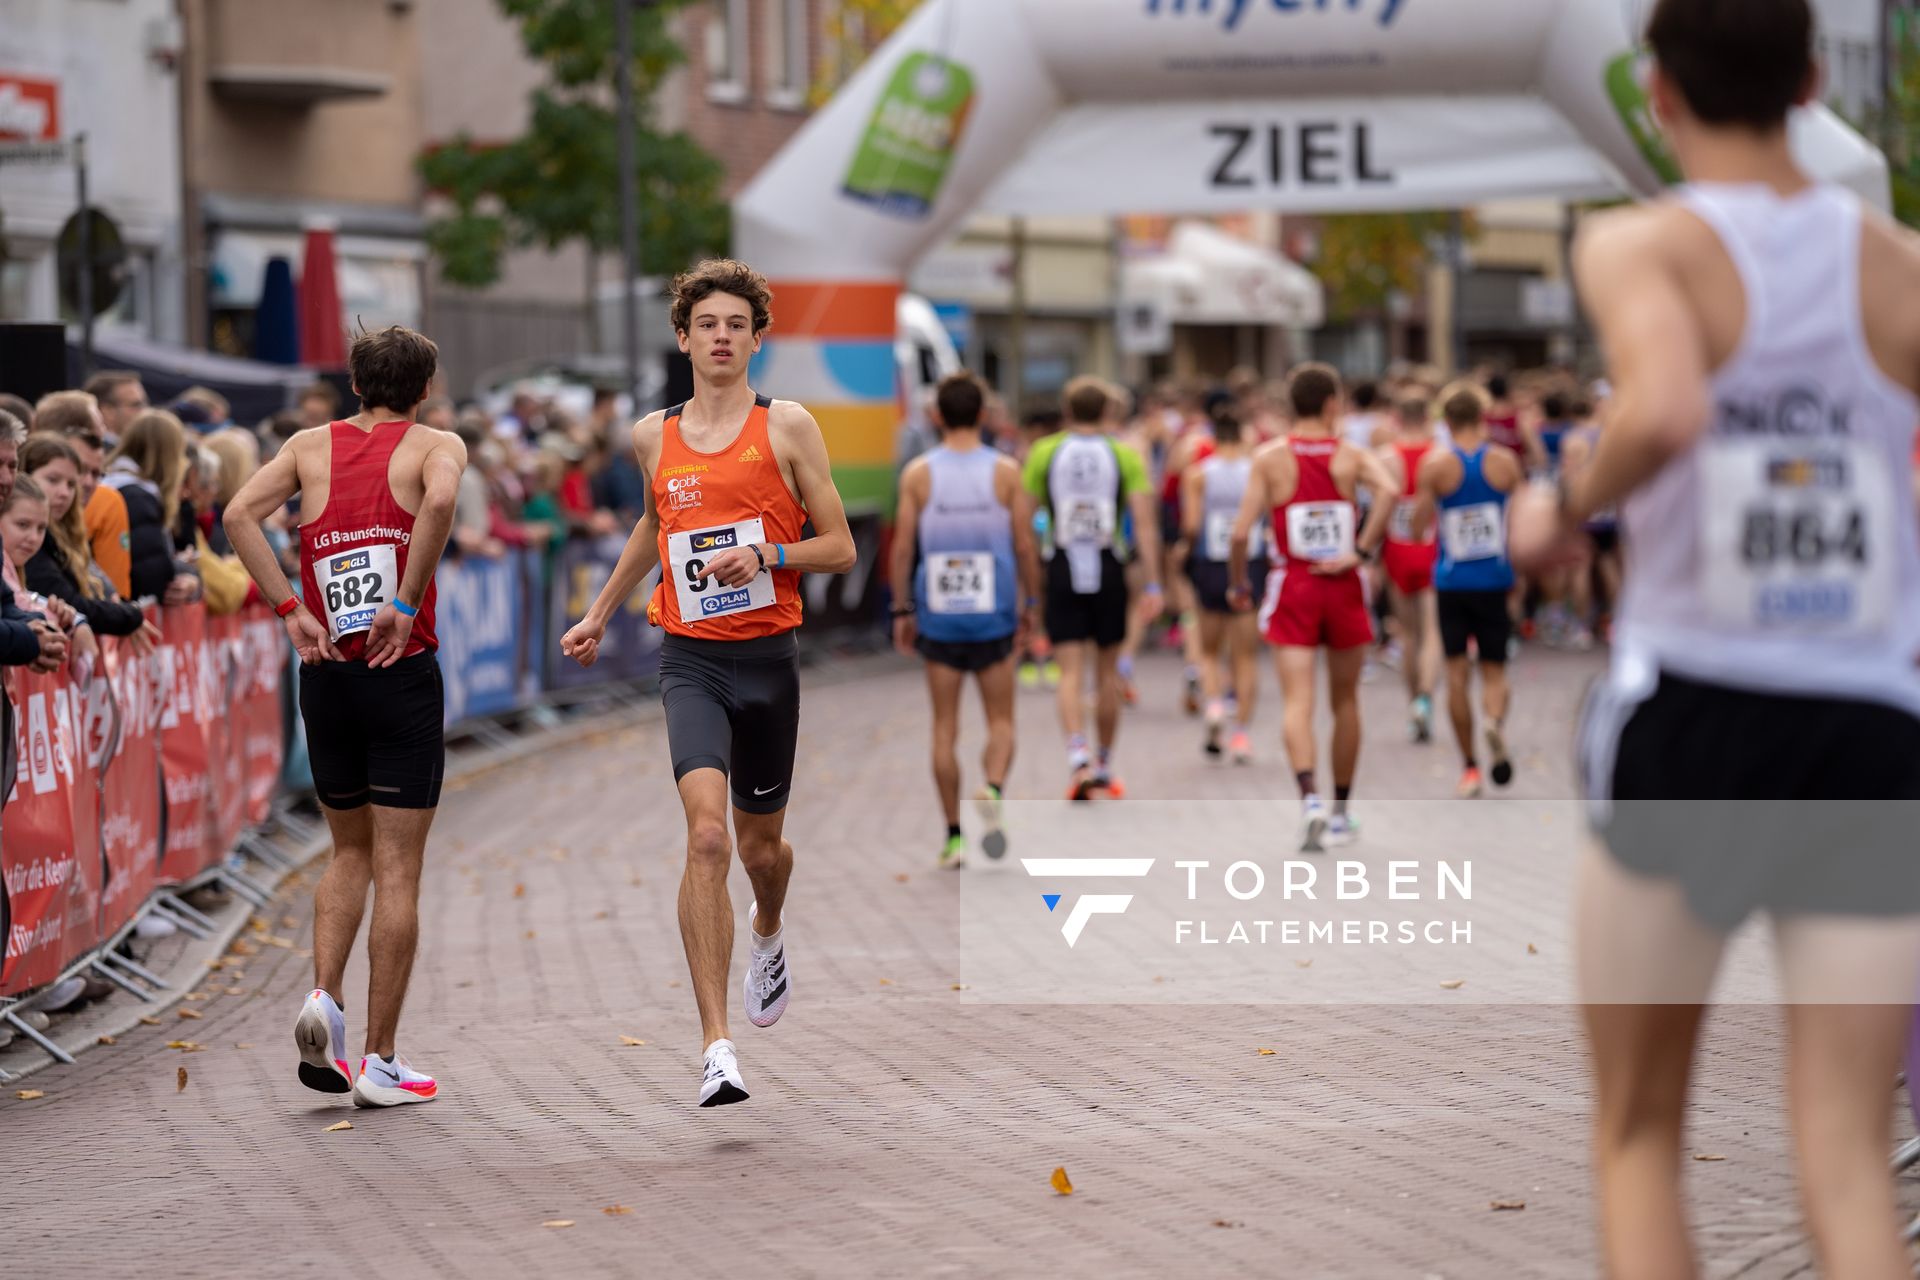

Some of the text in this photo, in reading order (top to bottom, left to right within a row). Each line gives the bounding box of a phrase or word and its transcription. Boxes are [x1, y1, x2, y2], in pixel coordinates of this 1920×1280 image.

[1208, 119, 1394, 188] ZIEL
[738, 454, 764, 463] adidas
[314, 533, 330, 550] LG
[715, 533, 733, 546] GLS
[350, 556, 366, 568] GLS
[326, 572, 384, 613] 682
[720, 592, 748, 605] PLAN
[351, 612, 375, 623] PLAN
